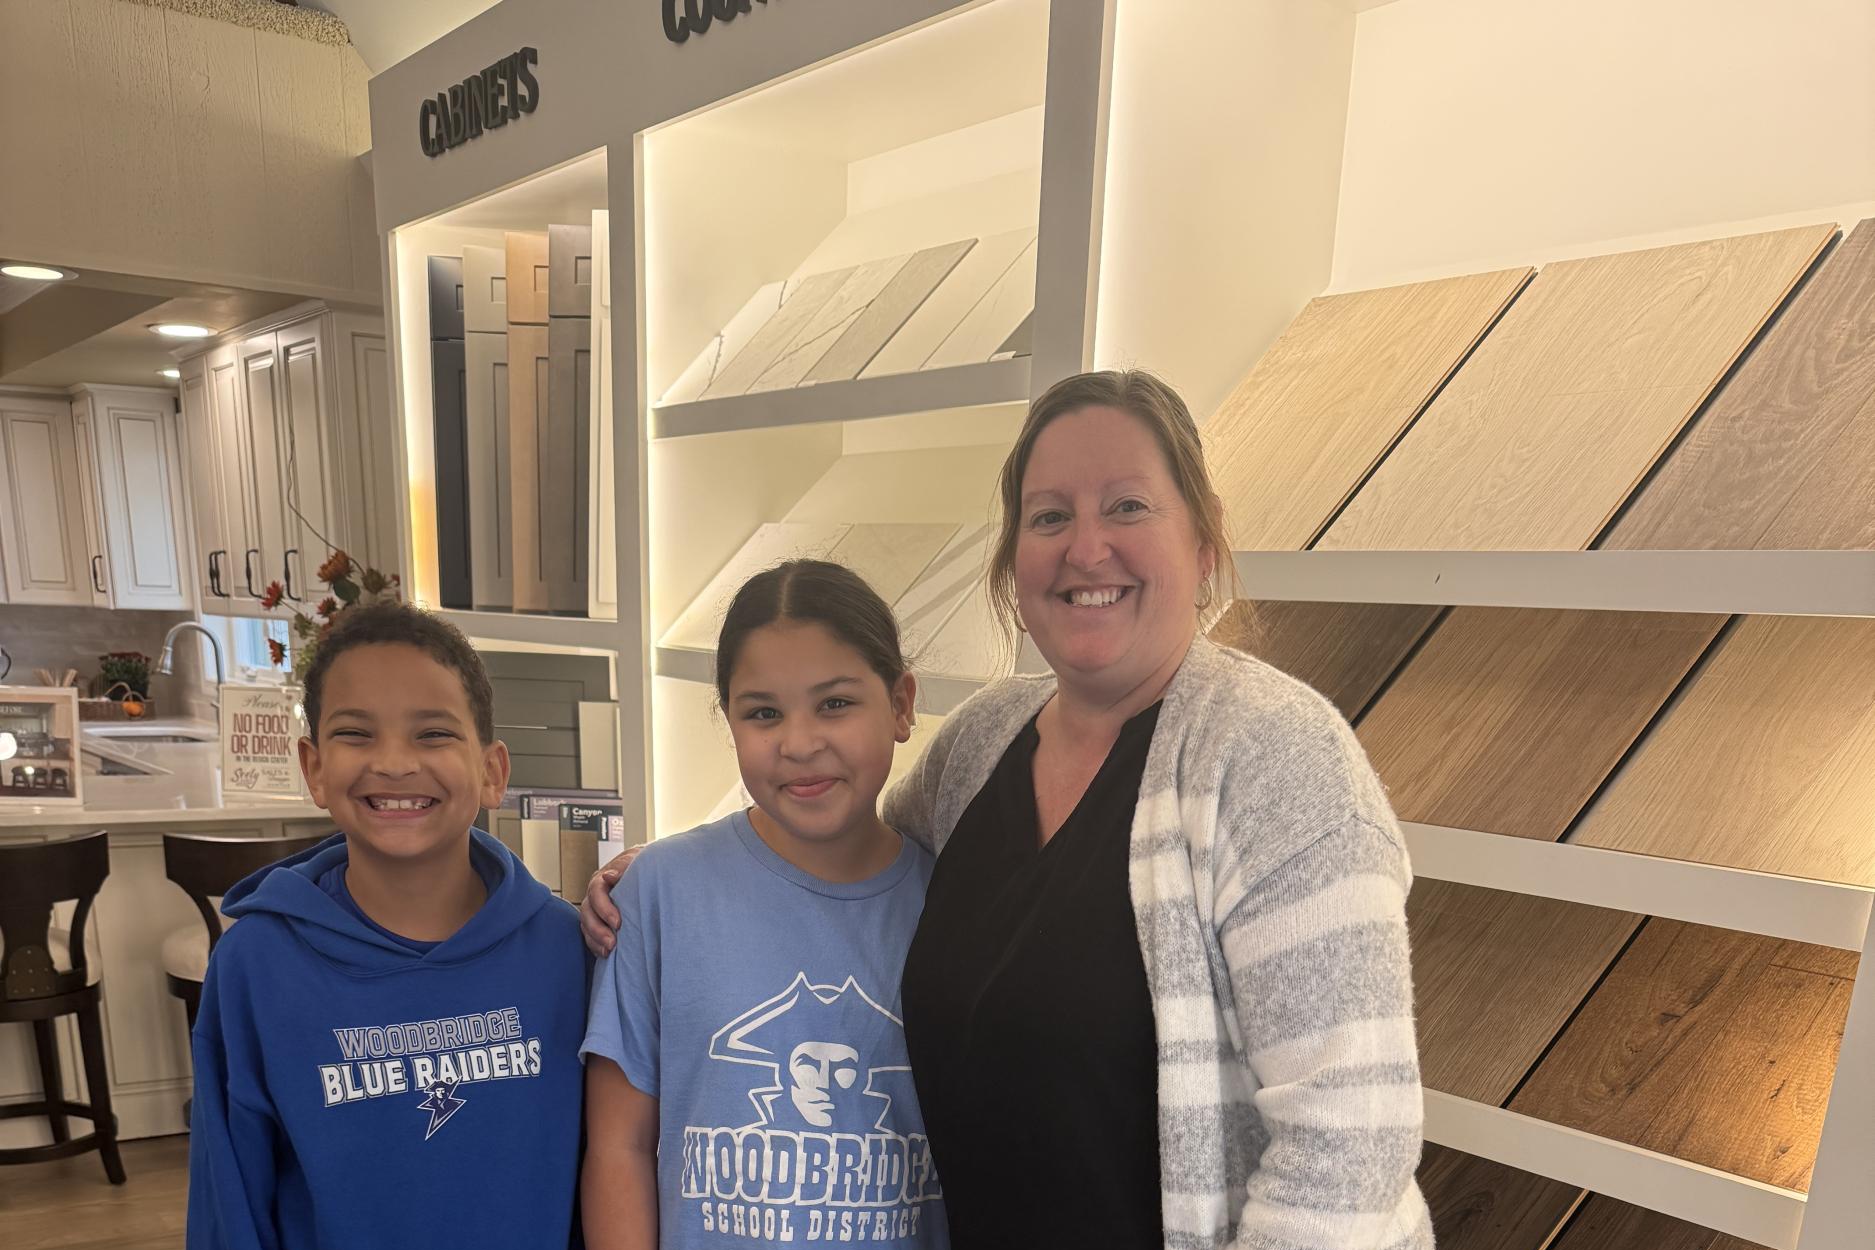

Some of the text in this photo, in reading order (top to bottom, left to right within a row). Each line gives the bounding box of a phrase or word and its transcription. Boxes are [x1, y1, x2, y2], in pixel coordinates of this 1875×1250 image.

[420, 46, 540, 158] CABINETS
[233, 713, 289, 735] NO FOOD
[231, 734, 292, 756] OR DRINK
[572, 807, 602, 817] Canyon
[333, 1006, 522, 1060] WOODBRIDGE
[318, 1036, 542, 1107] BLUE RAIDERS
[702, 1201, 921, 1242] SCHOOL DISTRICT
